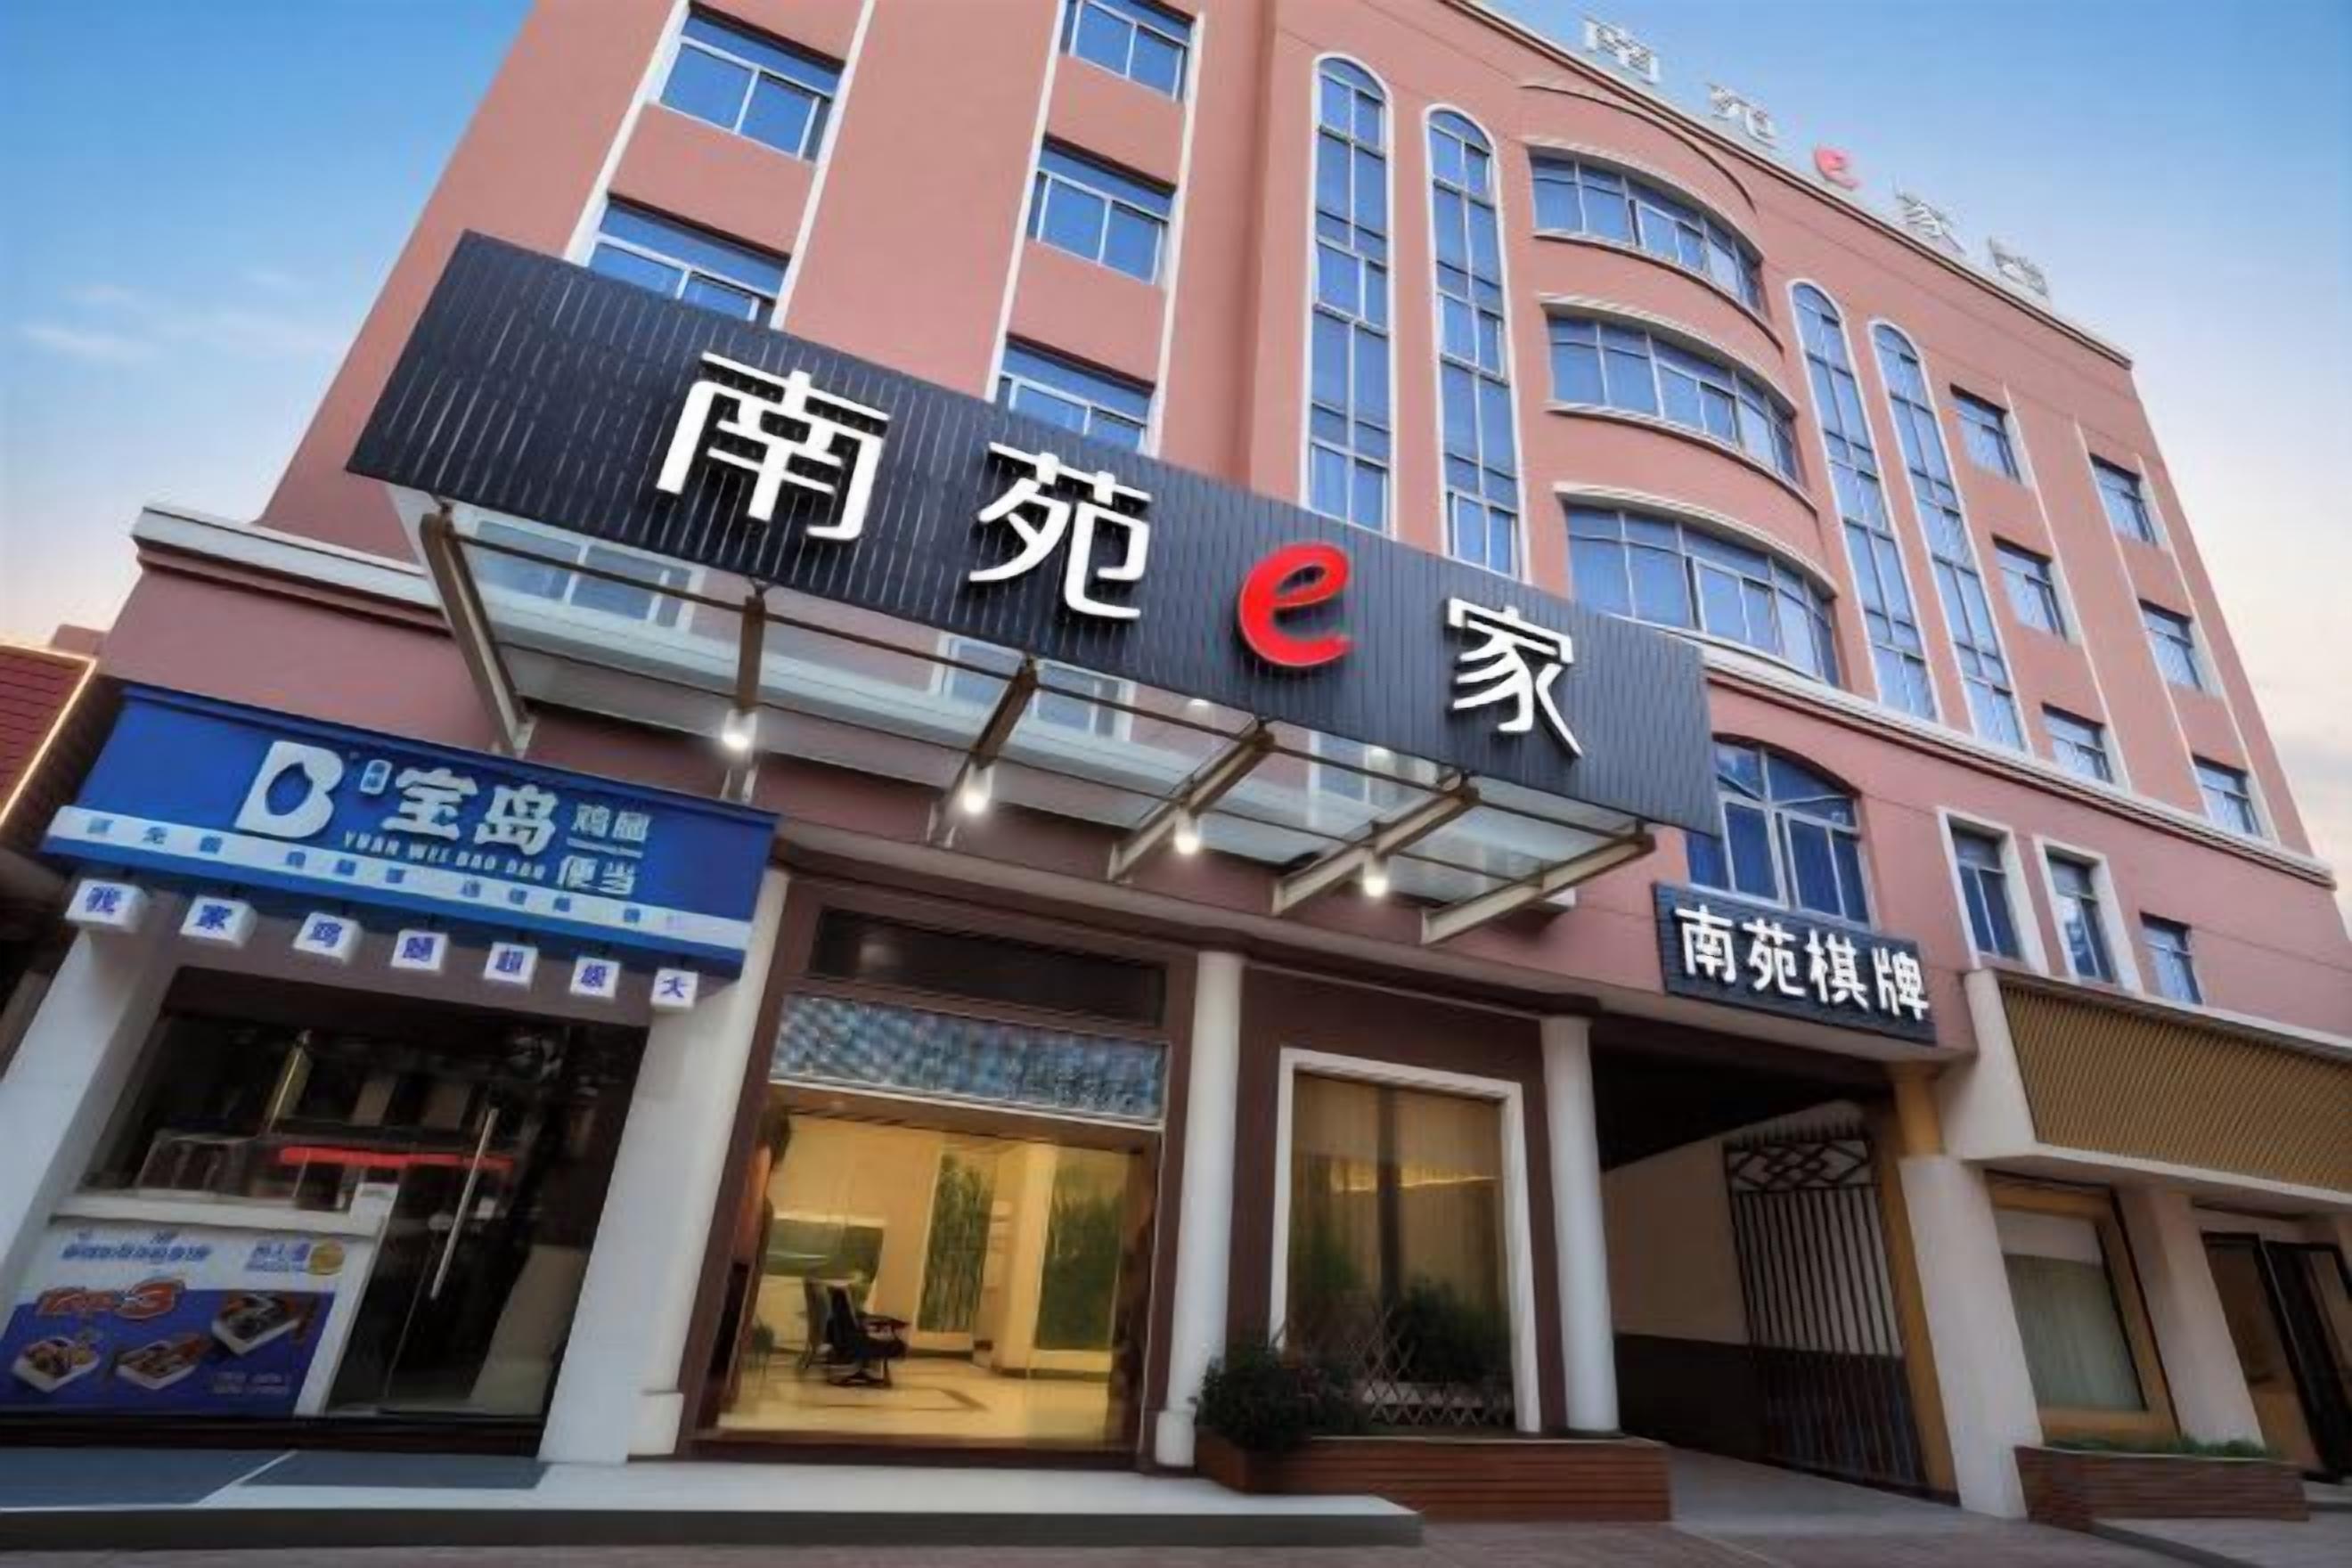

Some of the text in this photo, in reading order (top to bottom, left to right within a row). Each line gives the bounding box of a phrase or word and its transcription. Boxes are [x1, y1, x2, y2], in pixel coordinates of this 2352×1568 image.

[655, 351, 1583, 757] 南苑e家
[381, 767, 559, 856] 宝岛
[1674, 903, 1930, 1021] 南苑棋牌
